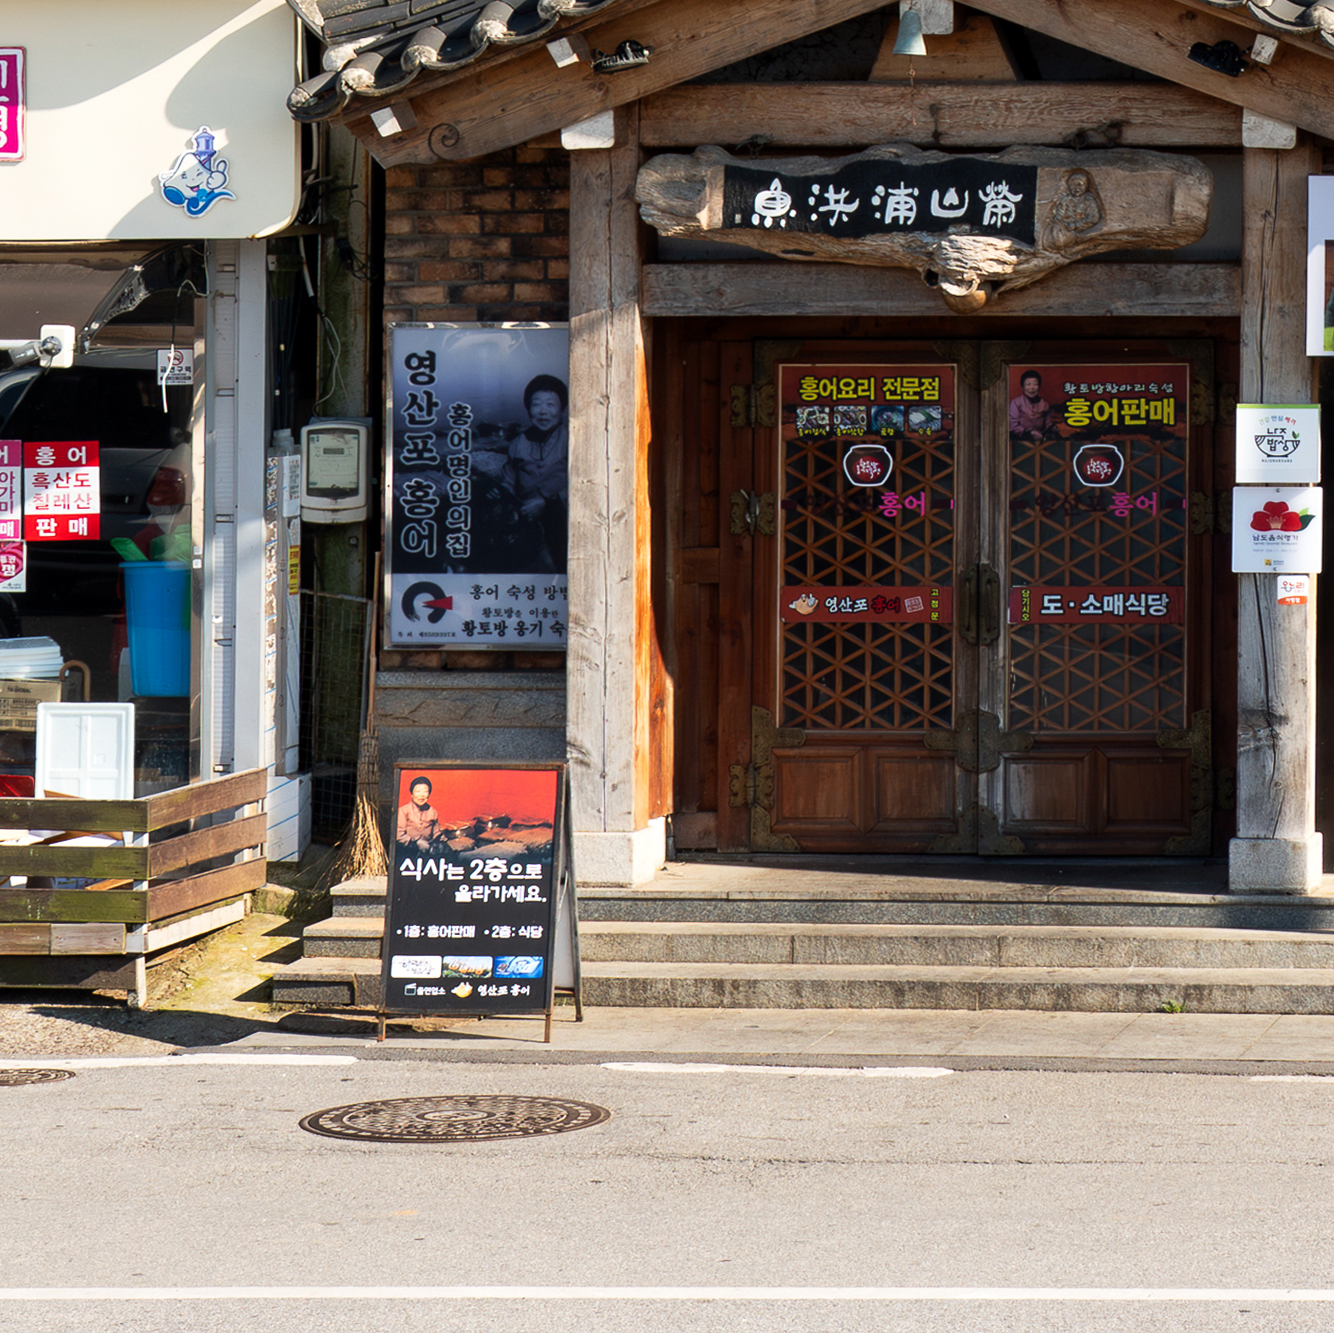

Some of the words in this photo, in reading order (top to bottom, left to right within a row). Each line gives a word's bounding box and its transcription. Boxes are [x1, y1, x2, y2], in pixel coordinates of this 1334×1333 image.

[799, 375, 876, 402] 홍어요리
[881, 376, 941, 402] 전문점
[400, 349, 440, 466] 영산포
[1063, 397, 1175, 427] 홍어판매
[31, 471, 92, 490] 흑산도
[32, 492, 93, 511] 칠레산
[878, 491, 926, 518] 홍어
[1109, 491, 1158, 518] 홍어
[400, 478, 440, 558] 홍어
[469, 584, 499, 601] 홍어
[506, 584, 536, 601] 숙성
[481, 606, 523, 619] 황토방을
[825, 596, 869, 613] 영산포
[871, 595, 901, 613] 홍어
[461, 619, 509, 638] 황토방
[513, 619, 544, 638] 옹기
[399, 857, 466, 882] 식사는
[468, 856, 544, 883] 2층으로
[454, 884, 548, 904] 올라가세요.
[403, 924, 425, 939] 1층:
[426, 924, 476, 939] 홍어판매
[491, 924, 516, 939] 2층:
[517, 924, 544, 939] 식당
[477, 984, 509, 997] 영산포
[509, 983, 531, 997] 홍어
